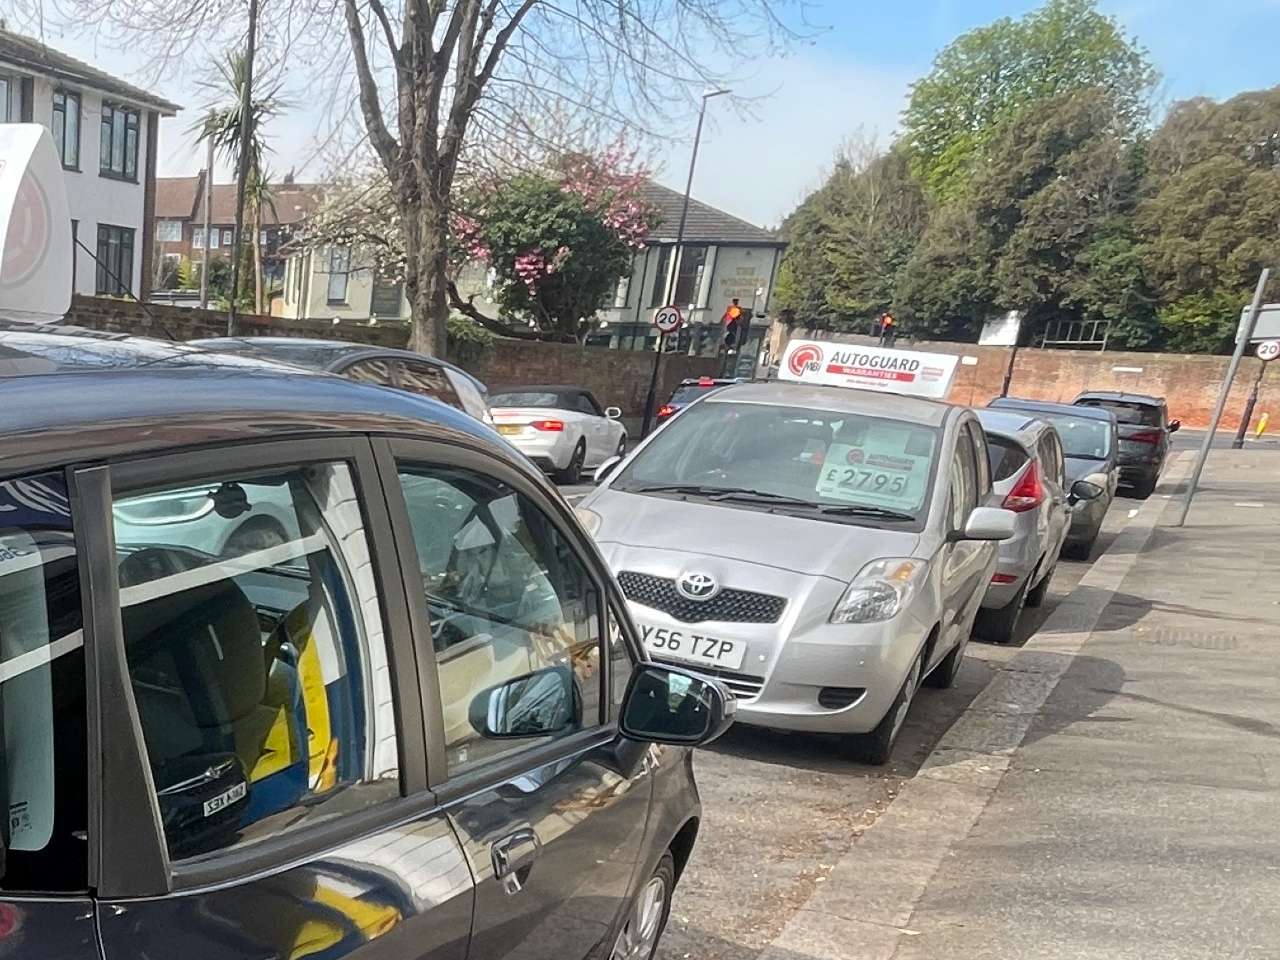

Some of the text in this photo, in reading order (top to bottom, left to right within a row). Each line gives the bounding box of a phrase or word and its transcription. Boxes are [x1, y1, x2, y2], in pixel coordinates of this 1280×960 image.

[659, 312, 677, 324] 20
[1260, 344, 1278, 355] 20
[829, 351, 920, 372] AUTOGUARD
[842, 367, 897, 380] WARRANTIES
[636, 624, 734, 660] Y56 TZP
